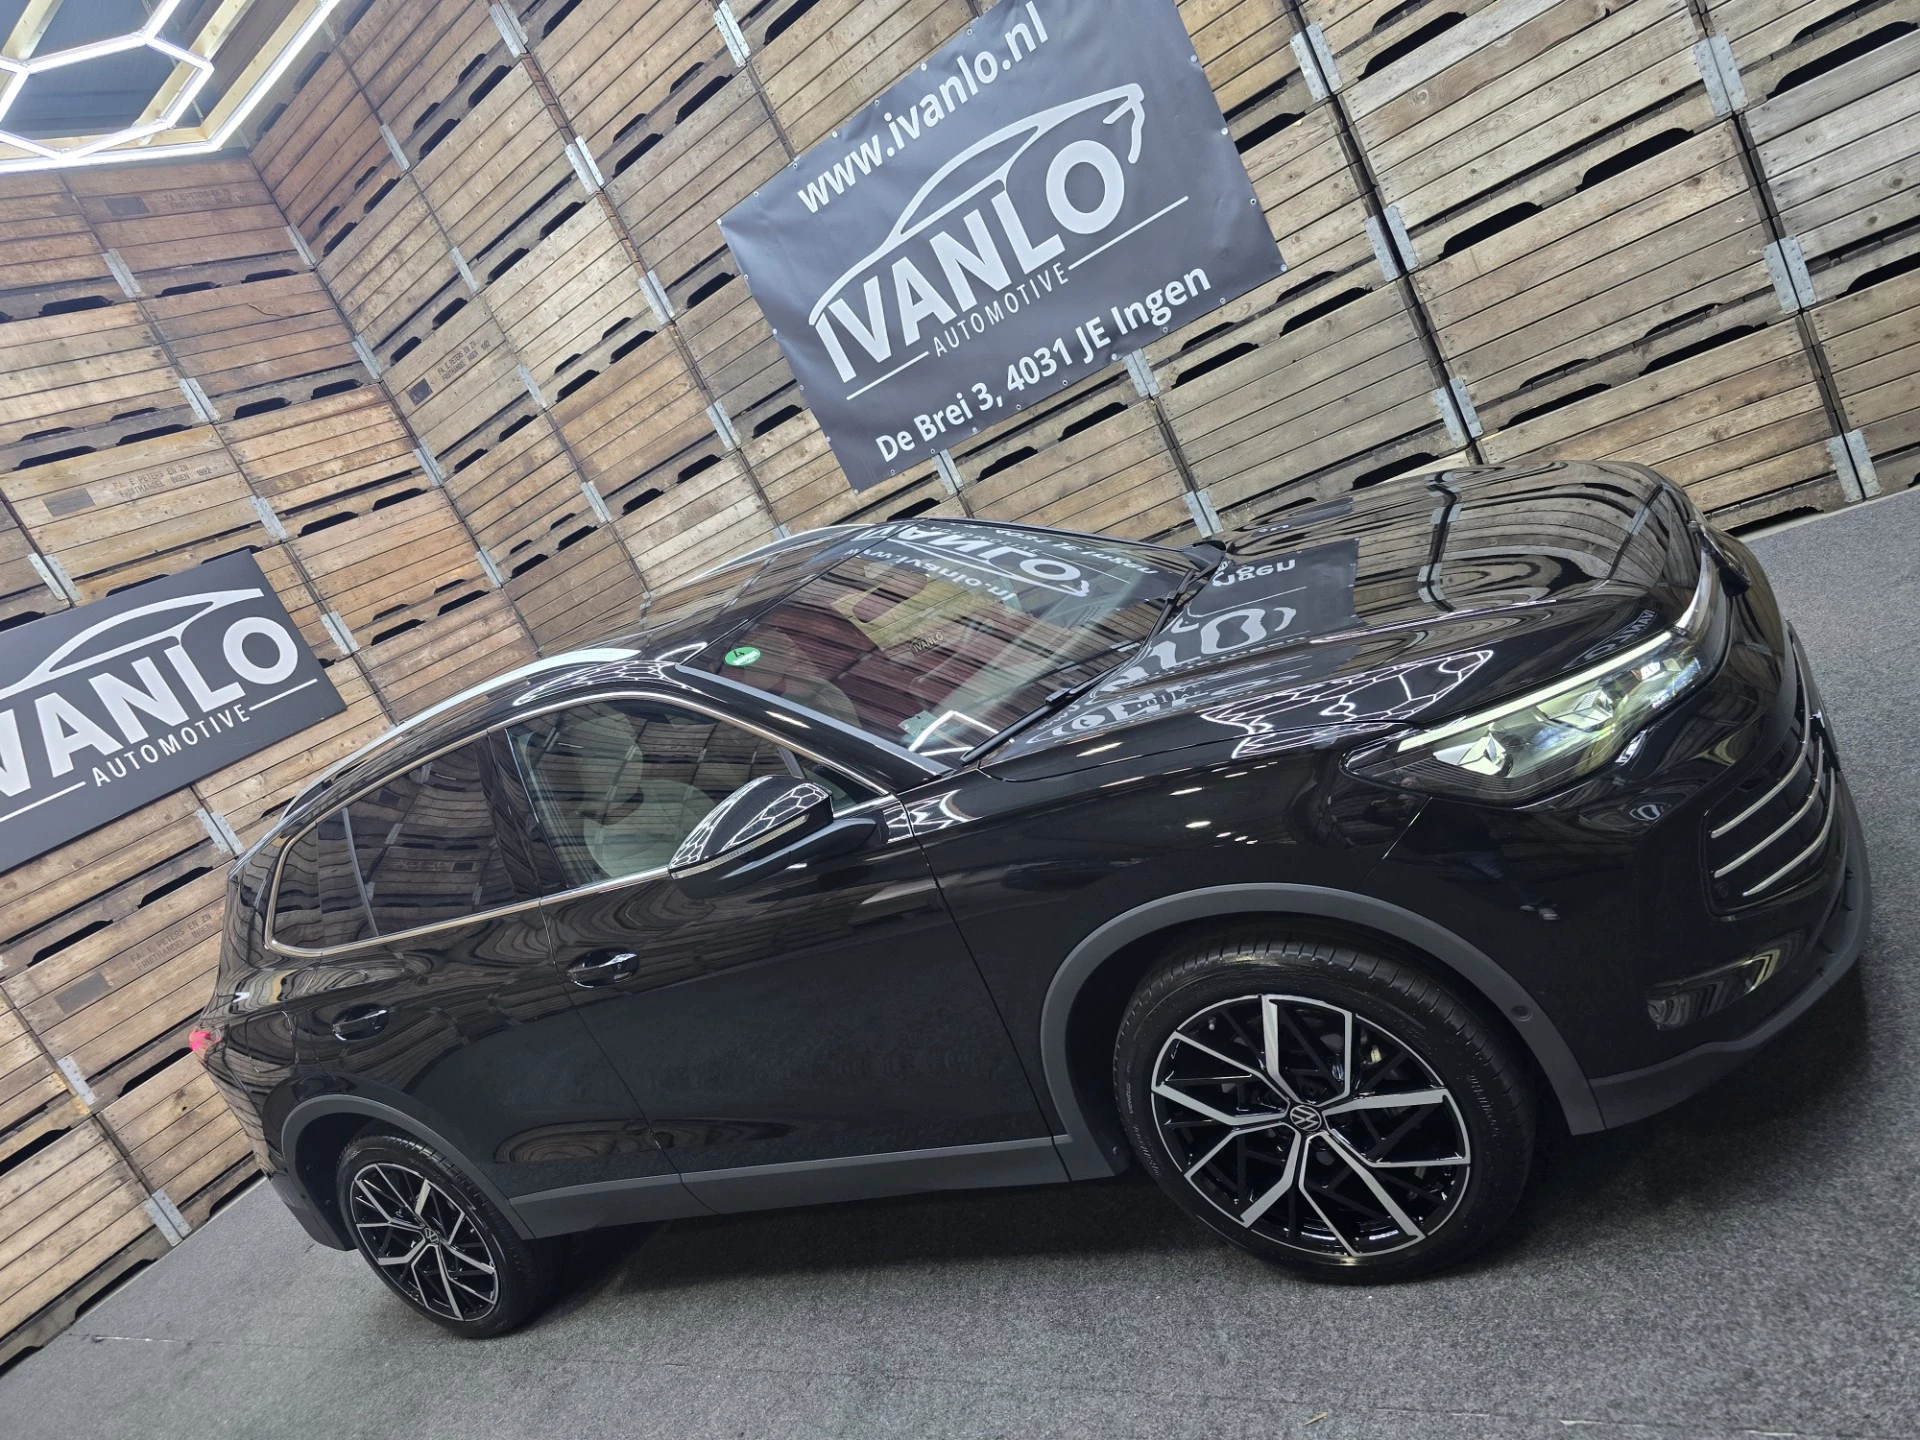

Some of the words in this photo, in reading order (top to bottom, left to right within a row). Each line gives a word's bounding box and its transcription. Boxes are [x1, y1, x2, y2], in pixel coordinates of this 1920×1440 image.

[797, 0, 1049, 214] www.ivanlo.nl
[814, 139, 1125, 384] IVANLO
[933, 262, 1070, 358] AUTOMOTIVE
[875, 428, 914, 463] De
[914, 397, 973, 443] Brei
[971, 382, 1004, 409] 3,
[1005, 338, 1073, 394] 4031
[1075, 316, 1111, 365] JE
[1110, 266, 1211, 335] Ingen
[913, 630, 944, 653] IVANLO
[91, 703, 251, 788] AUTOMOTIVE
[156, 929, 184, 947] PETERS
[187, 919, 199, 931] EN
